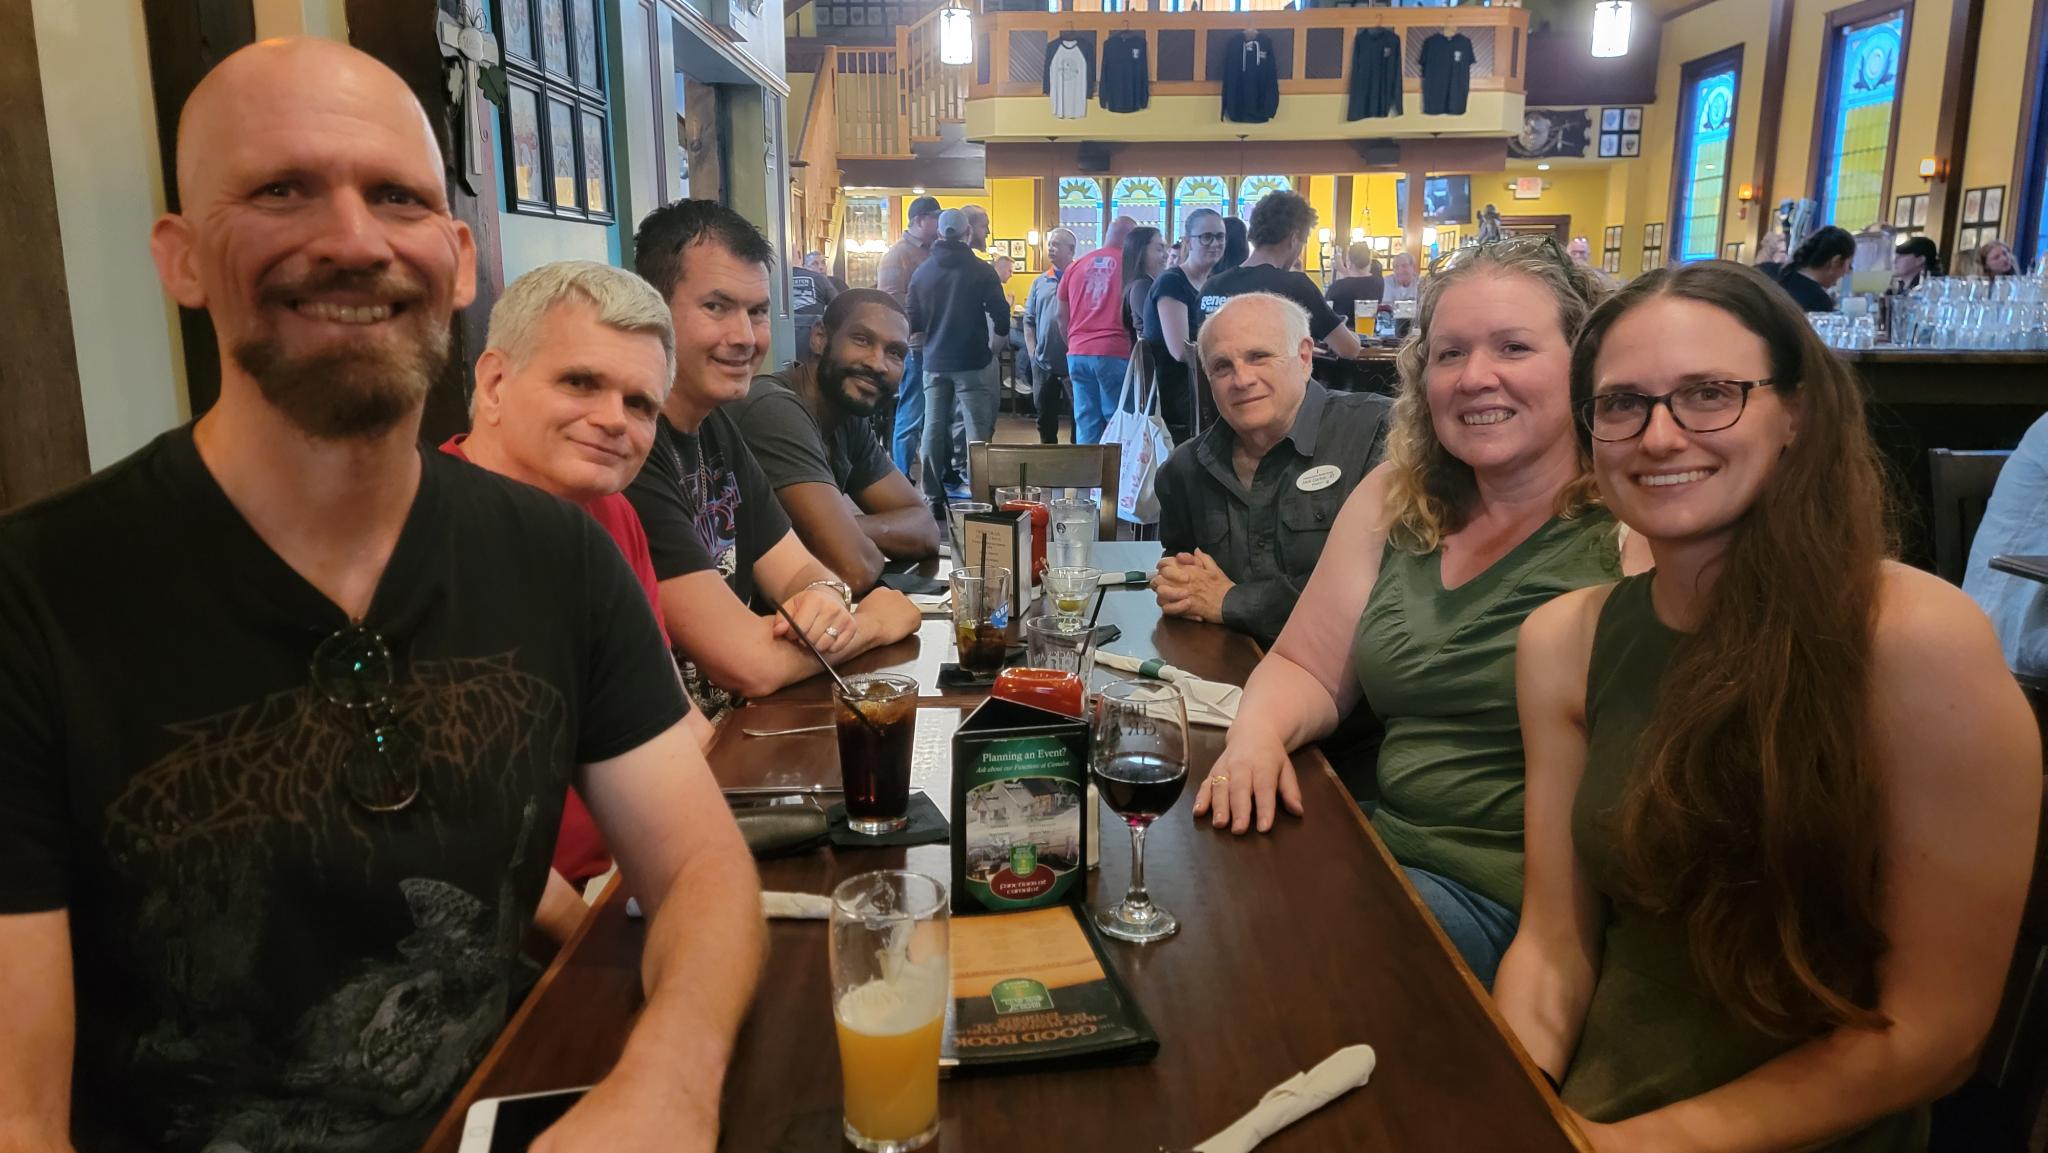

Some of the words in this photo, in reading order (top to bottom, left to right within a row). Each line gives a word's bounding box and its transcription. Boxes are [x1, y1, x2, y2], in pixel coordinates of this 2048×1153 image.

[982, 752, 1022, 763] Planning
[1024, 752, 1035, 760] an
[1038, 747, 1067, 759] Event?
[954, 1034, 1018, 1047] BOOK
[1023, 1024, 1098, 1042] GOOD
